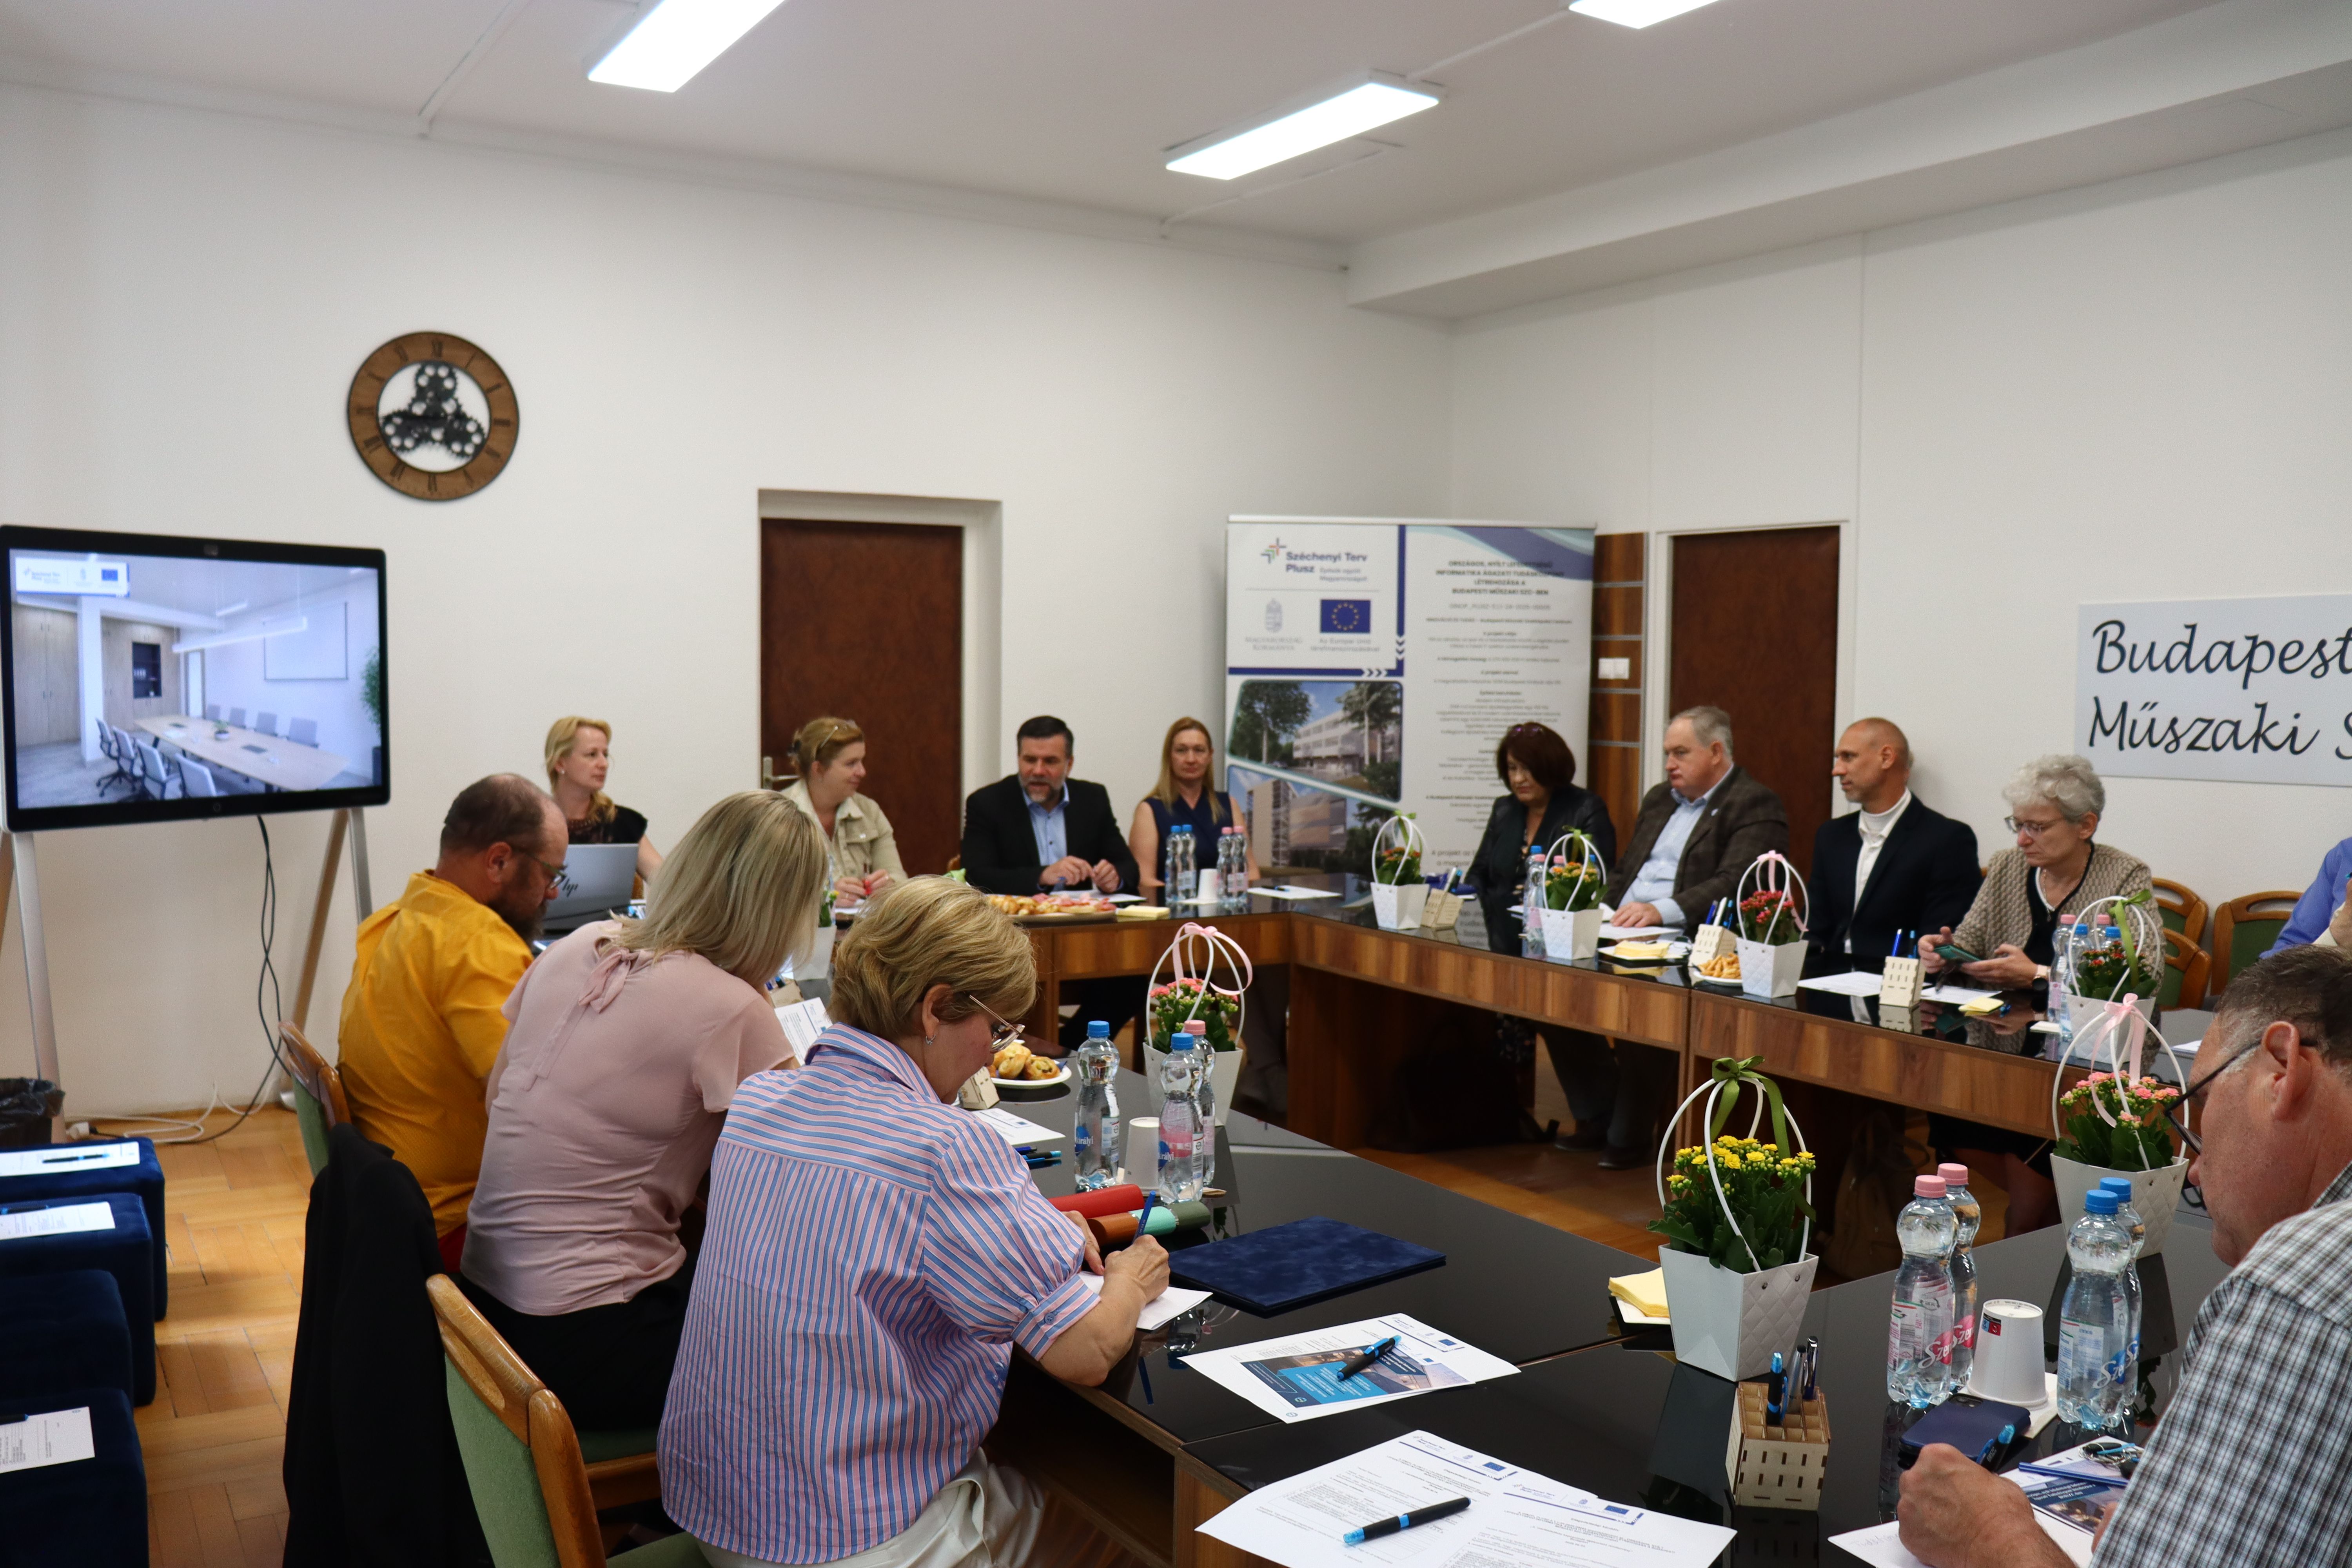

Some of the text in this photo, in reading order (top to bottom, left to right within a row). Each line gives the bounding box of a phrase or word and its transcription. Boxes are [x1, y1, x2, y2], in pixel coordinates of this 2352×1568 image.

[1286, 552, 1367, 562] Széchenyi Terv
[1286, 564, 1314, 573] Plusz
[2089, 696, 2320, 755] Műszaki
